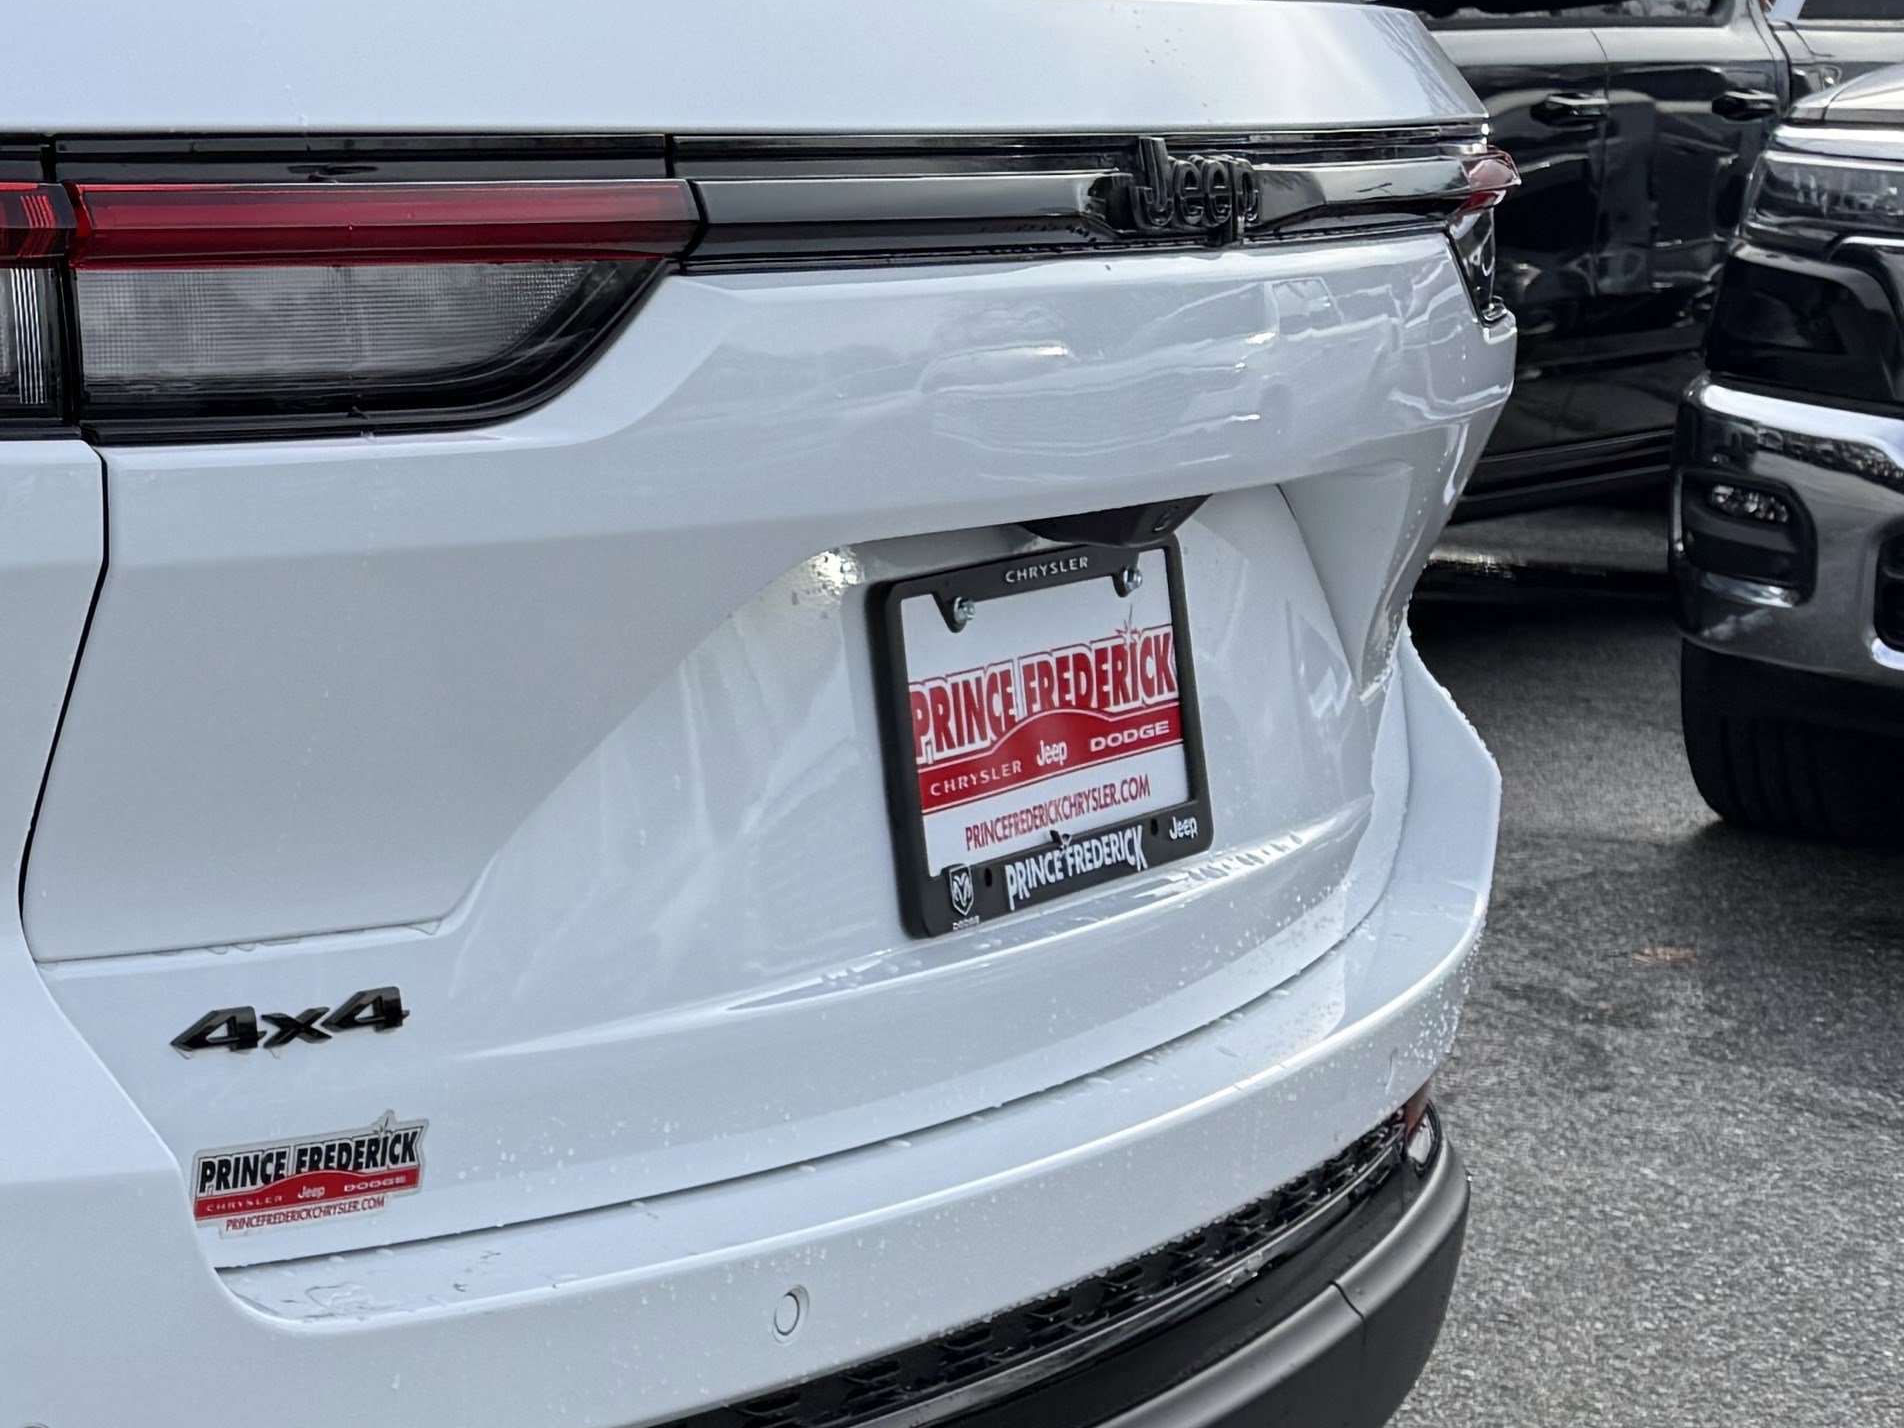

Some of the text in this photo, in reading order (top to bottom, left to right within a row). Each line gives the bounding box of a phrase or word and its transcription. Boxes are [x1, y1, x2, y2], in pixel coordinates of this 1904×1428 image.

[1129, 136, 1259, 245] Jeep
[1005, 556, 1089, 584] CHRYSLER
[910, 631, 1177, 759] PRINCE FREDERICK
[930, 720, 1170, 798] CHRYSLER Jeep DODGE
[965, 774, 1151, 851] PRINCEFREDERICKCHRYSLER.COM
[1169, 816, 1199, 841] Jeep
[1005, 825, 1148, 911] PRINCE FREDERICK
[198, 1129, 419, 1194] PRINCE FREDERICK
[206, 1174, 406, 1213] CHRYSLER Jeep DODGE
[226, 1195, 385, 1232] PRINCEFREDERICKCHRYSLER.COM
